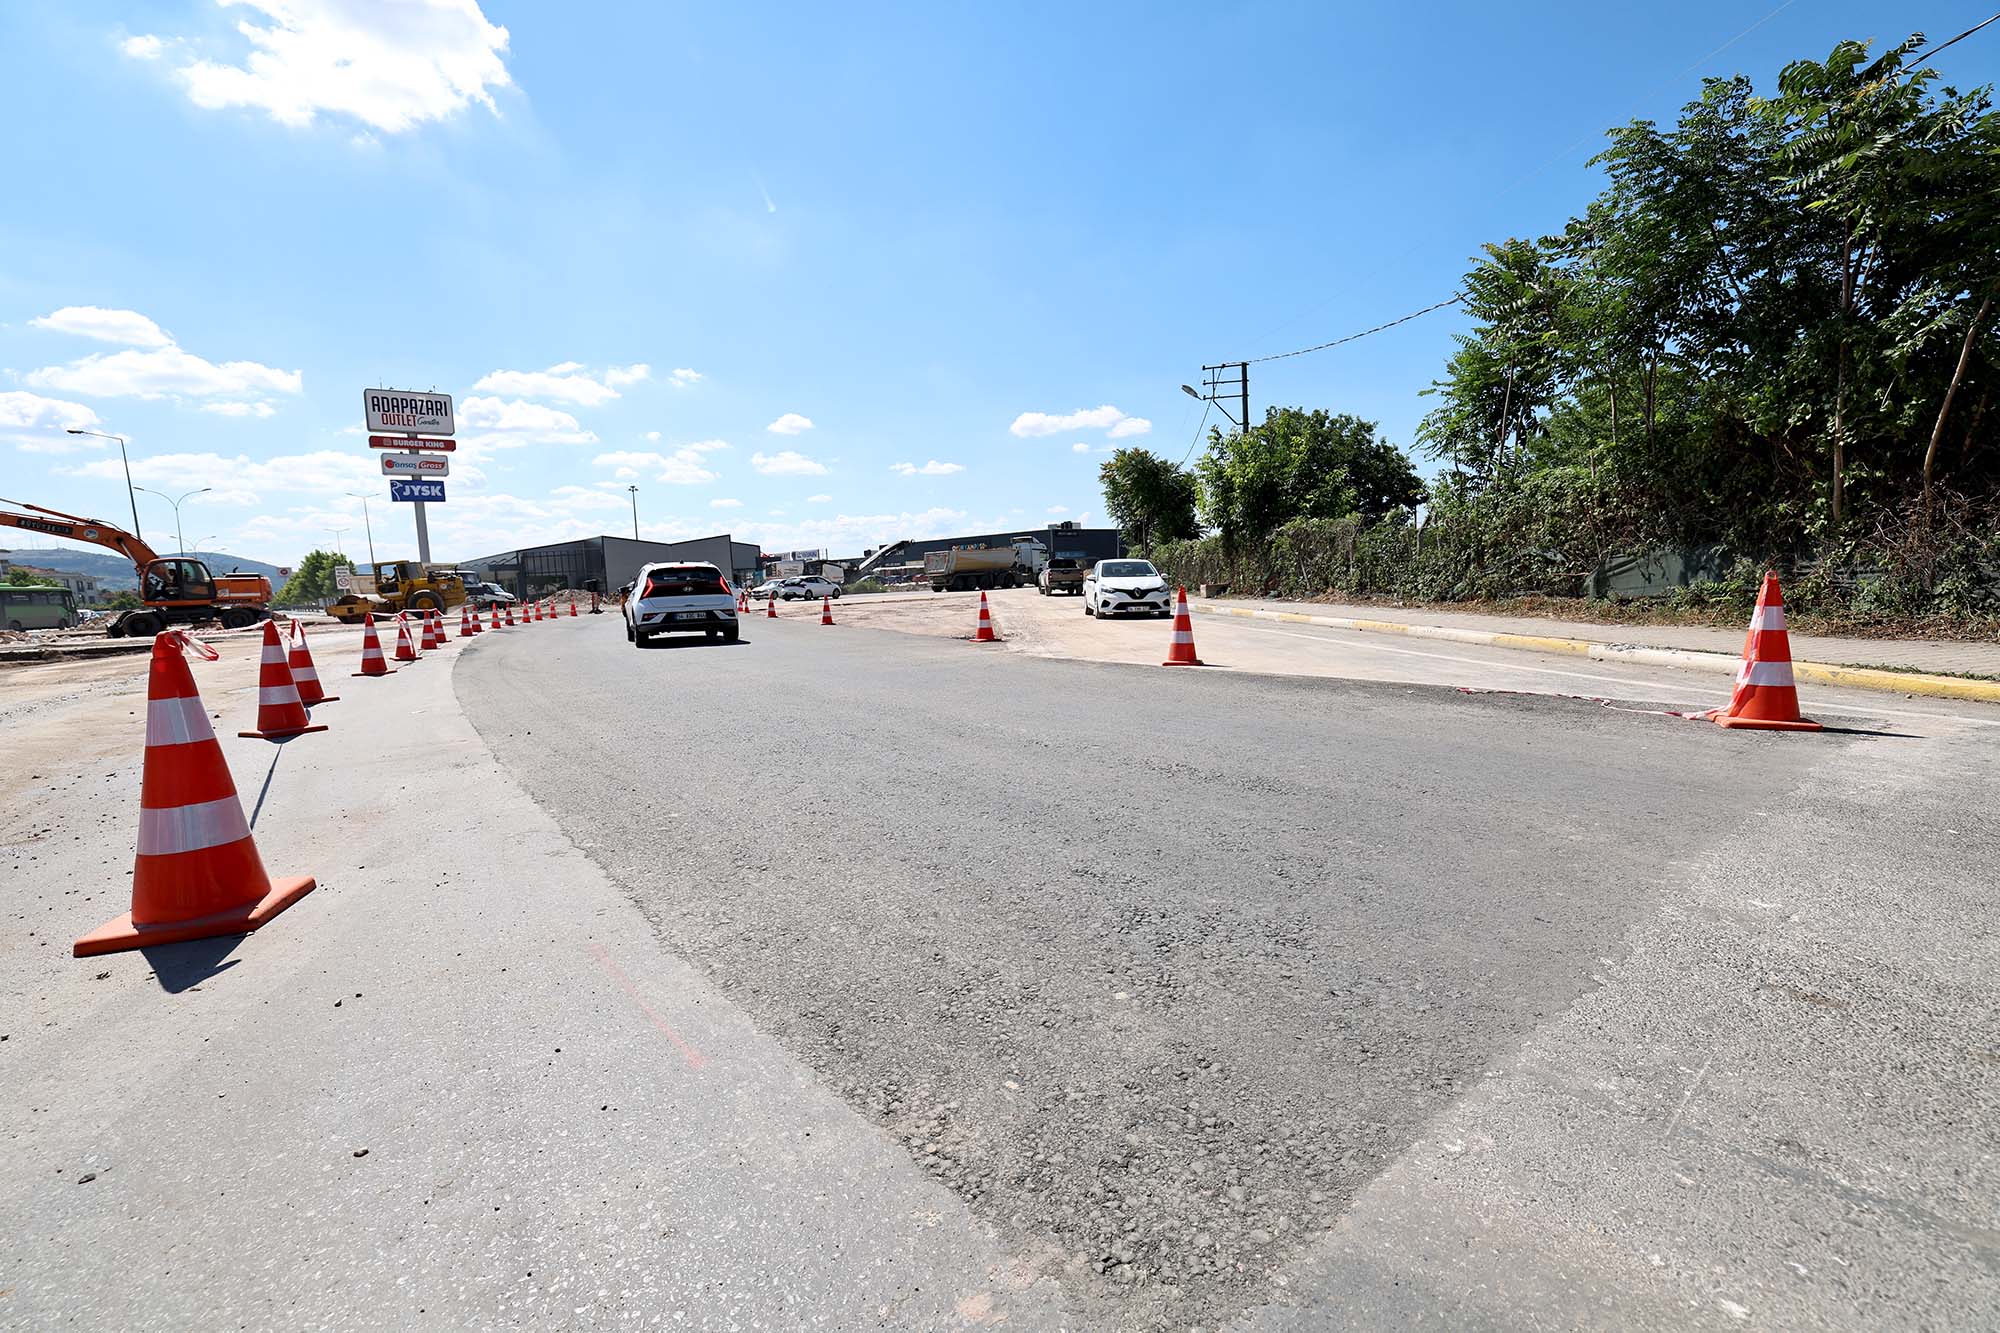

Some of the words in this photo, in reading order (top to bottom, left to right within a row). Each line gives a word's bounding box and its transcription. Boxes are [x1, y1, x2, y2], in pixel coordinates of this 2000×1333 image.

[371, 396, 448, 416] ADAPAZARI
[381, 413, 416, 427] OUTLET
[392, 439, 424, 448] BURGER
[425, 440, 445, 448] KING
[403, 485, 442, 496] JYSK
